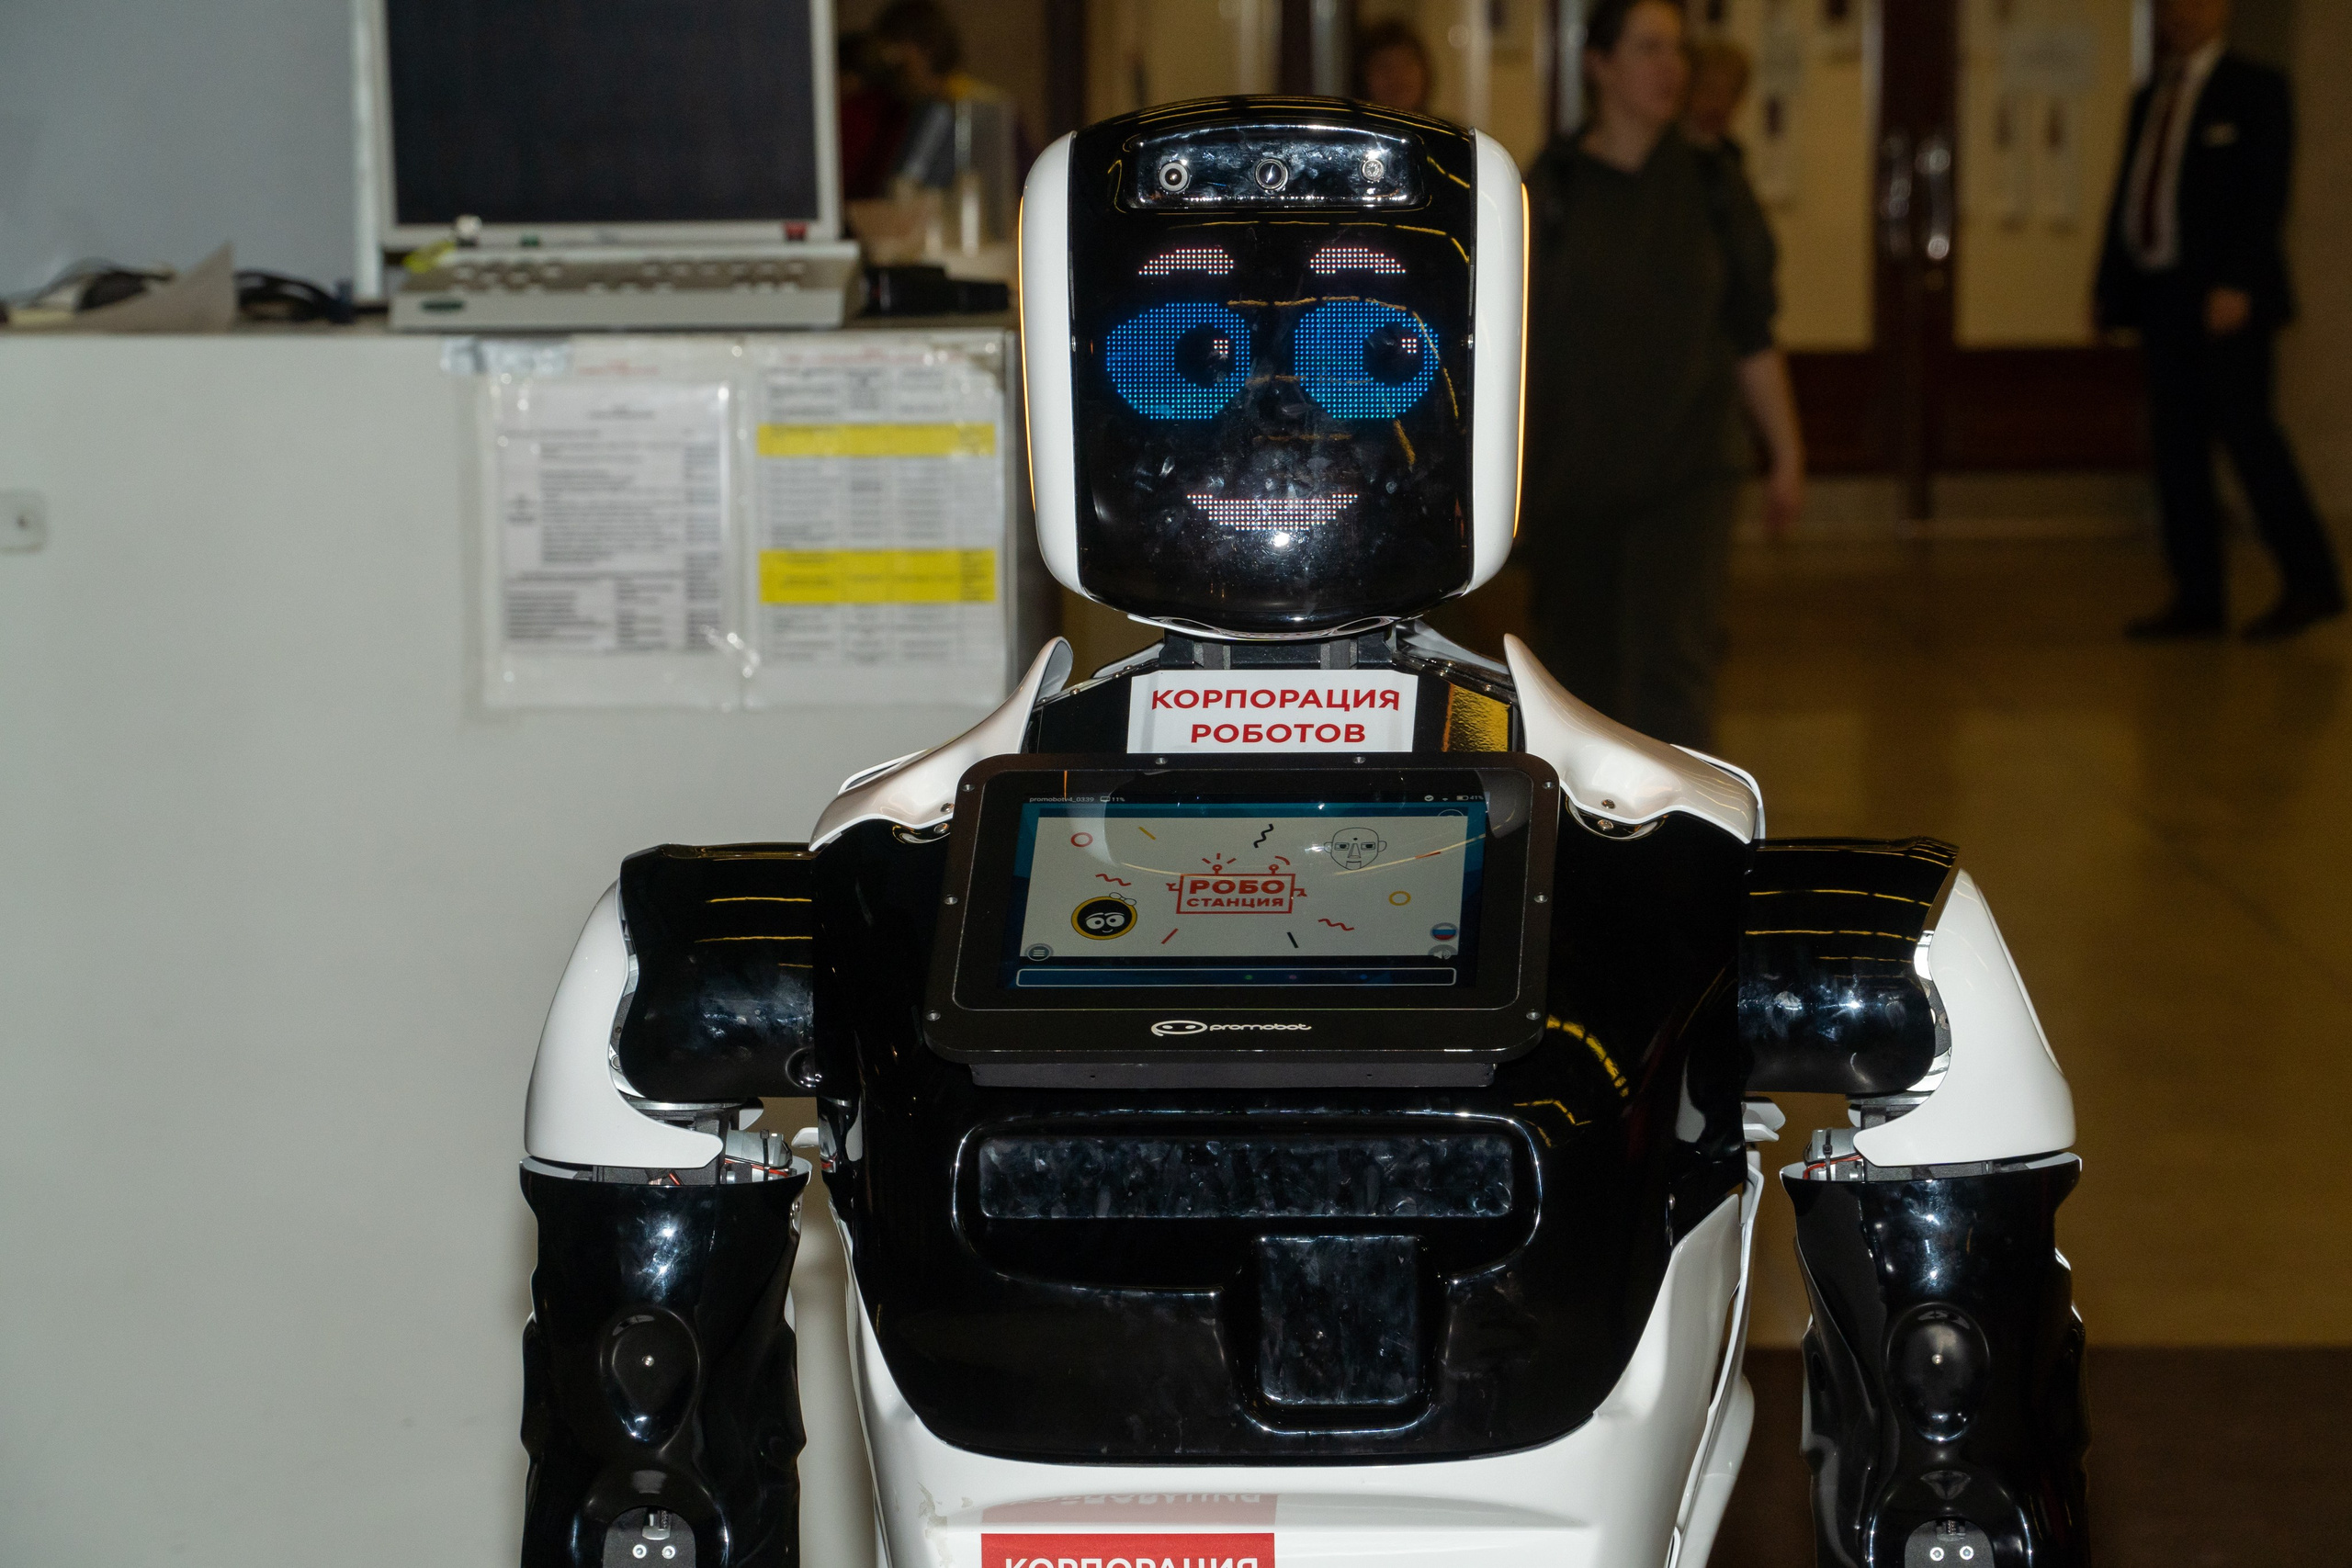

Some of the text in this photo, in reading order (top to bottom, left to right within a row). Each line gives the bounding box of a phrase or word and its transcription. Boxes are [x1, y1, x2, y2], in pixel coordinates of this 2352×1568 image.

[1151, 689, 1400, 712] КОРПОРАЦИЯ
[1191, 723, 1366, 743] РОБОТОВ
[1189, 879, 1286, 895] РОБО
[1186, 897, 1284, 908] СТАНЦИЯ
[1209, 1023, 1312, 1032] promobot
